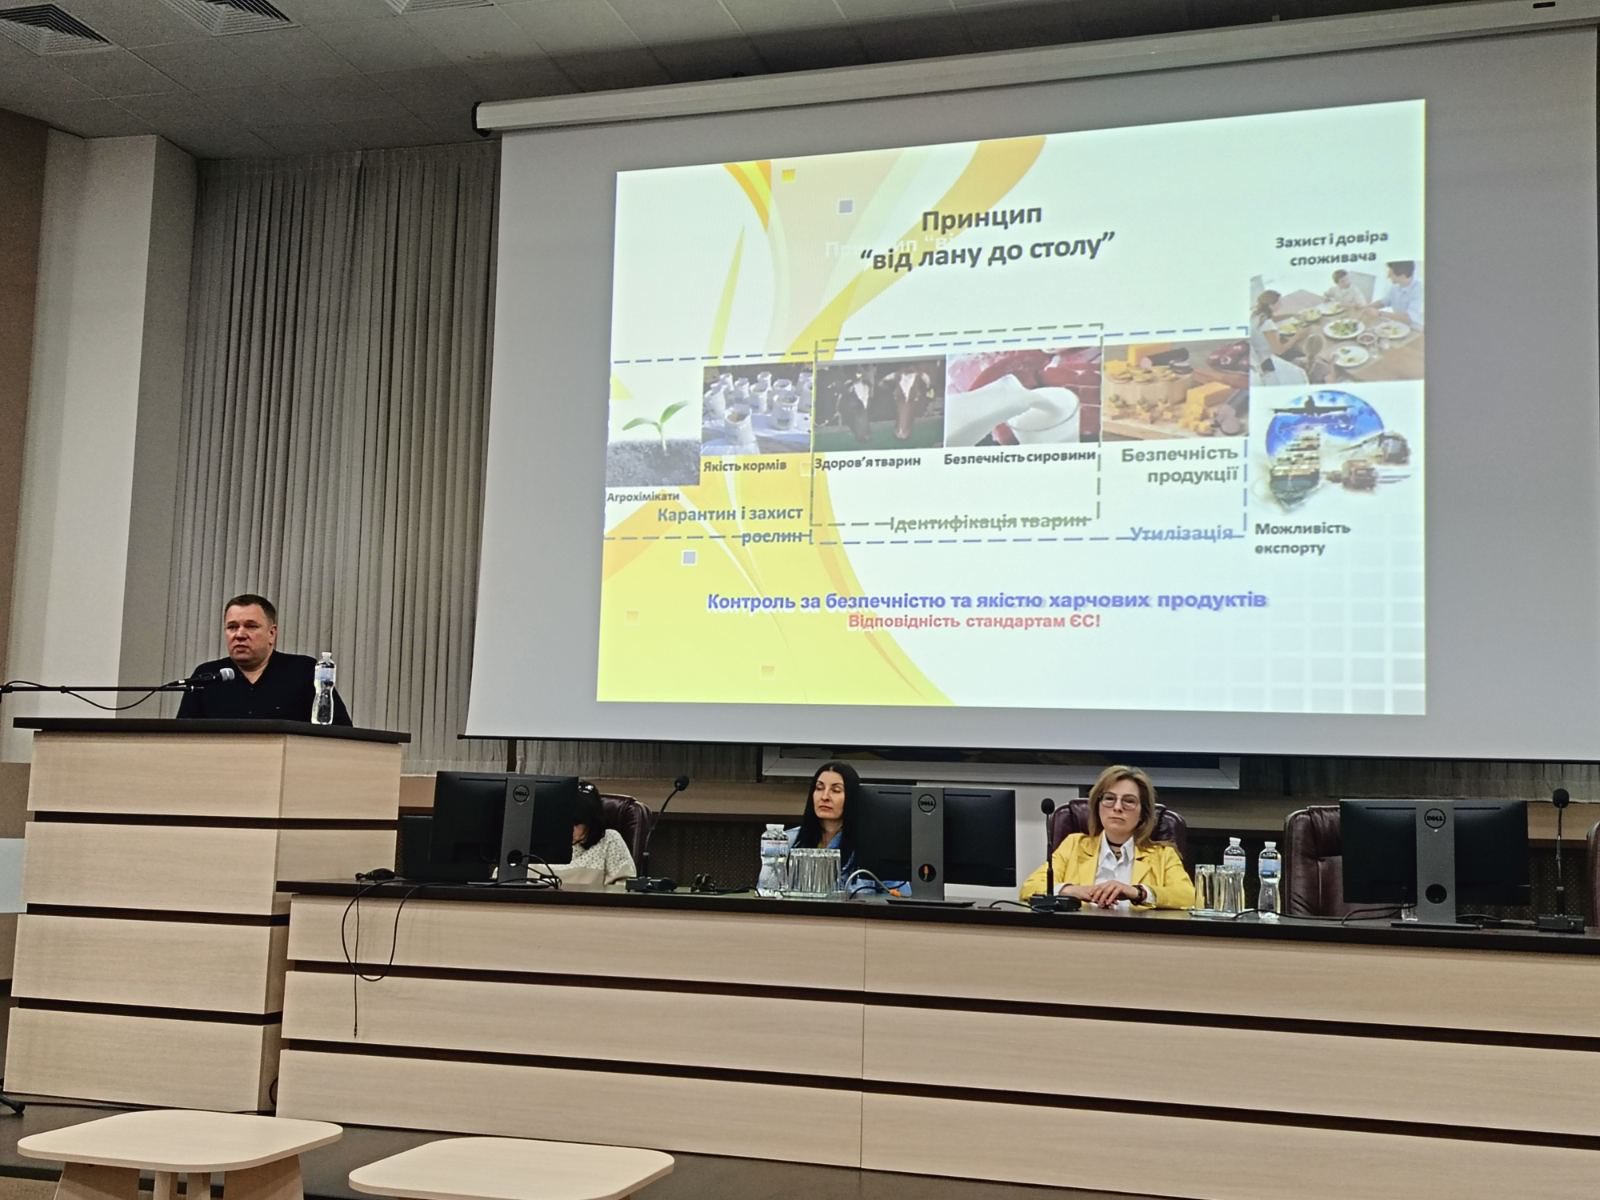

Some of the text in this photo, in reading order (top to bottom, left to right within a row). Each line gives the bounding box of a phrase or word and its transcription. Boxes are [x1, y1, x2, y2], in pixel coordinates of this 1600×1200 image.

[921, 206, 1042, 234] Принцип
[1275, 236, 1327, 249] Захист
[1335, 230, 1389, 248] довіра
[918, 246, 982, 268] лану
[987, 243, 1023, 266] до
[1290, 252, 1377, 266] споживача
[874, 455, 921, 470] тварин
[944, 449, 1096, 466] Безпечність сировини
[1121, 445, 1239, 463] Безпечність
[703, 459, 787, 474] Якість кормів
[1147, 466, 1239, 487] продукції
[607, 491, 680, 503] Агрохімікати
[657, 506, 803, 524] Карантин і захист
[889, 513, 1088, 532] Ідентифікація тварин
[1130, 524, 1234, 543] Утилізація
[1255, 522, 1351, 536] Можливість
[741, 530, 803, 547] рослин
[1254, 542, 1326, 556] експорту
[707, 590, 1267, 613] Контроль за безпечністю та якістю харчових продуктів
[848, 613, 1101, 630] Відповідність стандартам ЄС!
